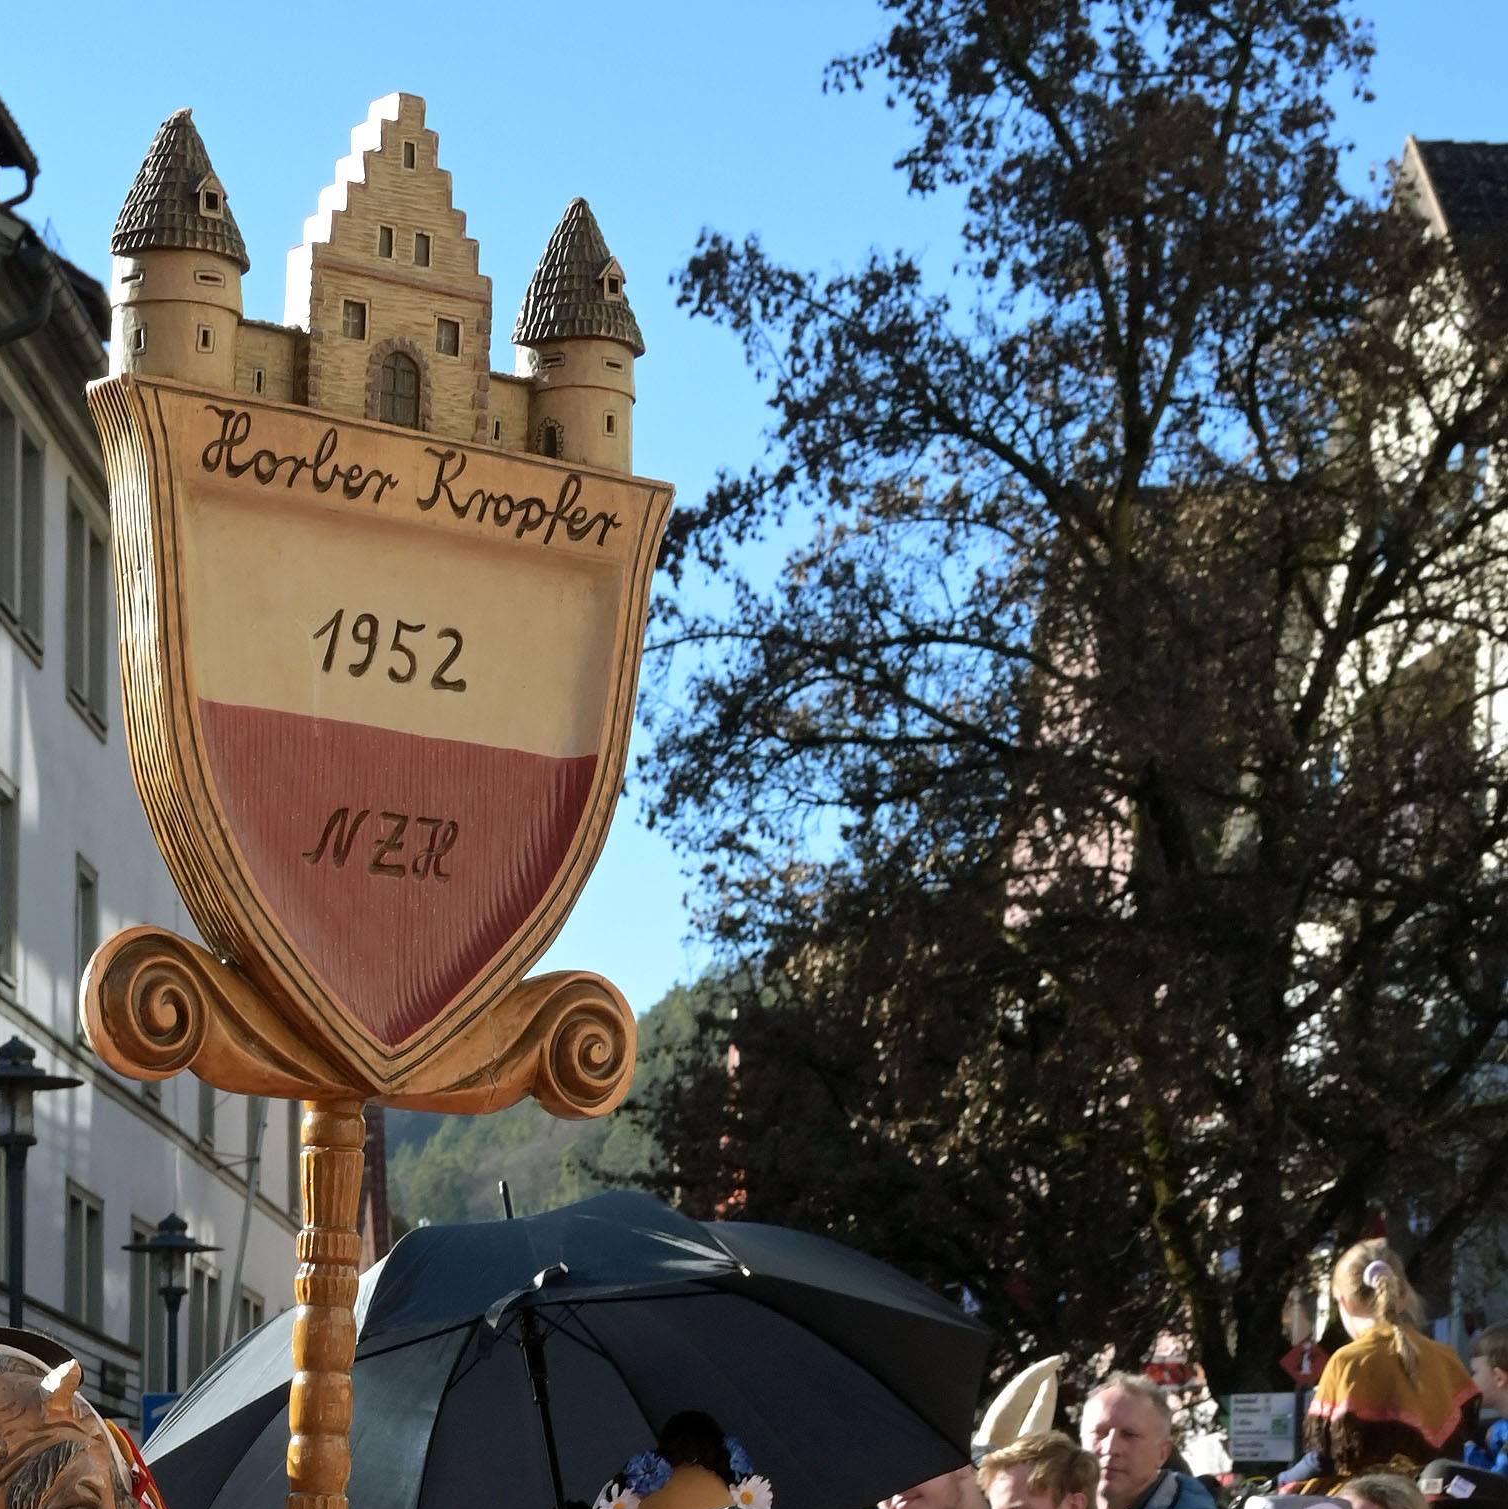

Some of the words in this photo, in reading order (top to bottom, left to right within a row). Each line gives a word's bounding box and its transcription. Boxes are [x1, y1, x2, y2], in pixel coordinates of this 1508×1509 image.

[201, 404, 400, 503] Horber
[417, 446, 623, 549] Kropfer
[313, 607, 468, 695] 1952
